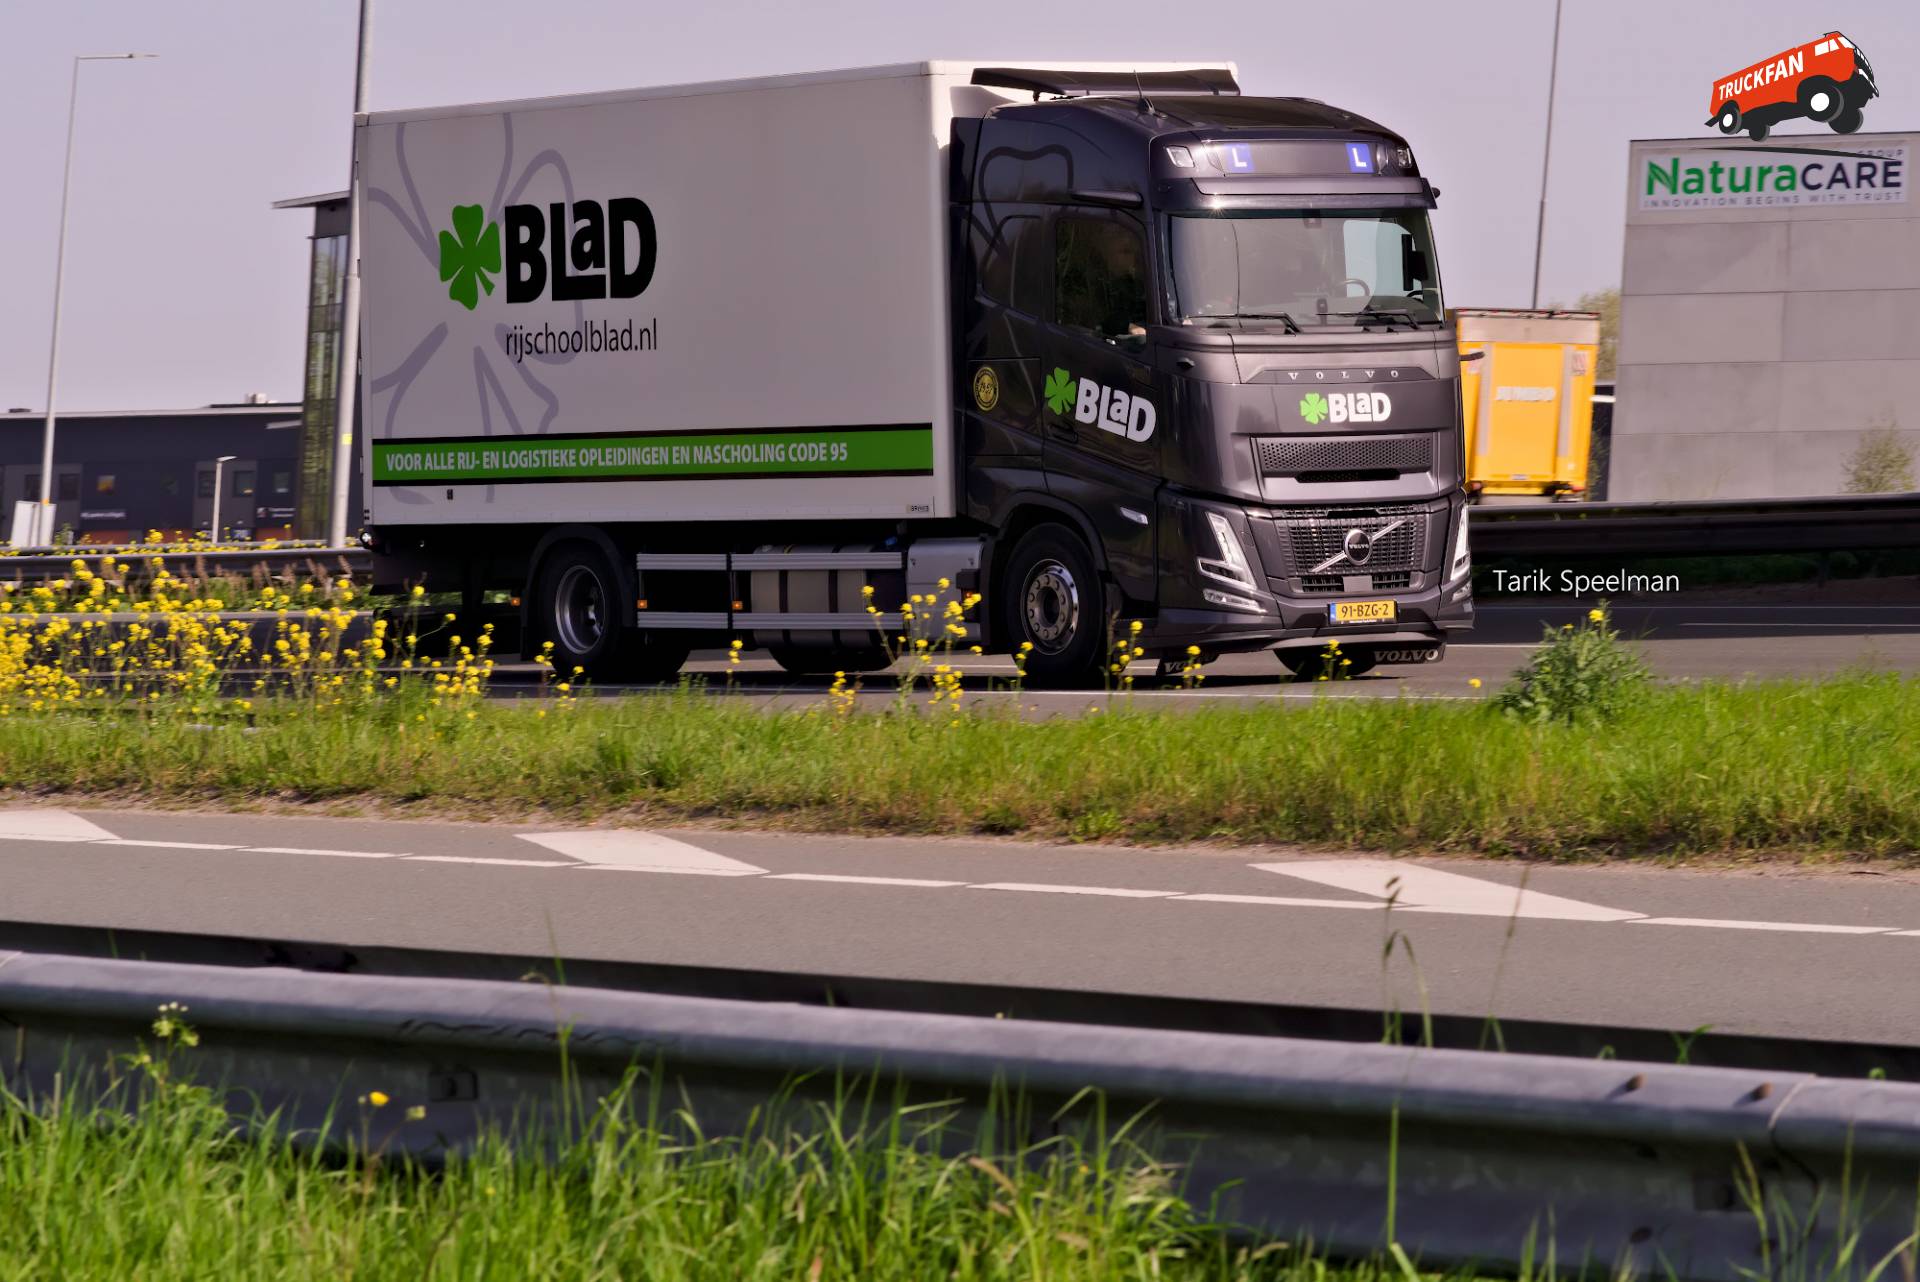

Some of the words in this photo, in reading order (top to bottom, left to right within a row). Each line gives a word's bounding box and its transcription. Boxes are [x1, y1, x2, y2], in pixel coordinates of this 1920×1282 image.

[1231, 147, 1247, 167] L
[1352, 147, 1367, 167] L
[1646, 157, 1903, 196] NaturaCARE
[1643, 197, 1738, 209] INNOVATION
[1745, 194, 1800, 206] BEGINS
[1808, 193, 1846, 203] WITH
[1854, 191, 1902, 202] TRUST
[505, 318, 657, 363] rijschoolblad.nl
[1287, 369, 1400, 381] VOLVO
[386, 452, 422, 472] VOOR
[424, 451, 455, 471] ALLE
[457, 451, 480, 470] RIJ-
[483, 450, 500, 470] EN
[502, 448, 577, 469] LOGISTIEKE
[579, 446, 669, 467] OPLEIDINGEN
[672, 445, 691, 465] EN
[693, 442, 786, 465] NASCHOLING
[788, 442, 827, 462] CODE
[830, 442, 849, 462] 95
[1341, 603, 1389, 619] 91-BZG-2
[1373, 648, 1438, 662] VOLVO
